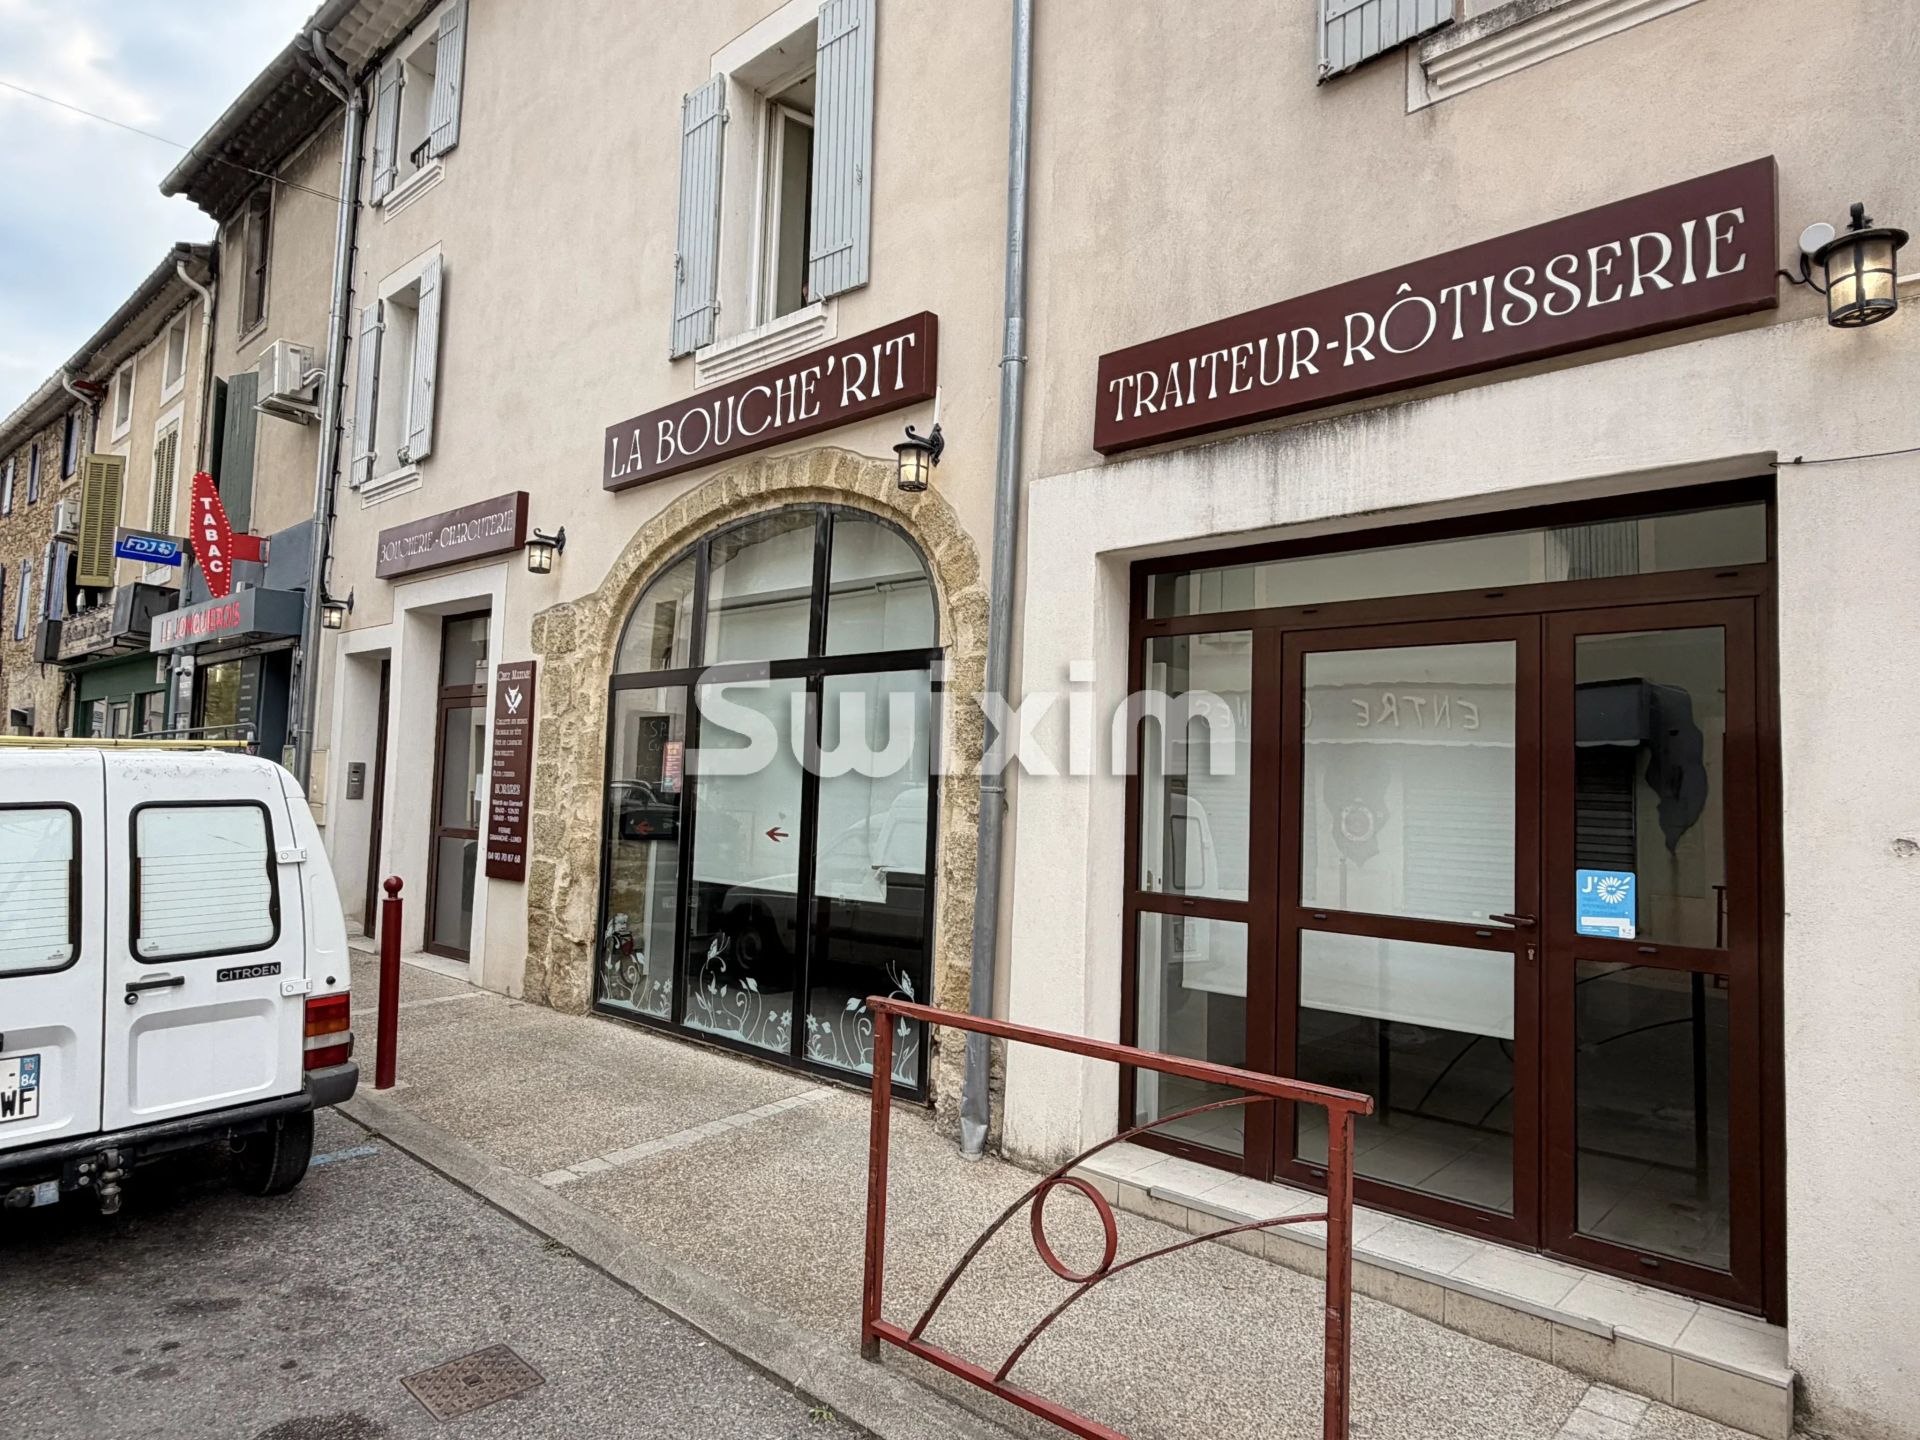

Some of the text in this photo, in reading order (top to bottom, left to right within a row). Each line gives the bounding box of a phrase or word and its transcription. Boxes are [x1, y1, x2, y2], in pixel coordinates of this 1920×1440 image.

[1108, 207, 1747, 422] TRAITEUR-RÔTISSERIE
[611, 332, 916, 478] LA BOUCHE'RIT
[125, 538, 158, 553] FDJ
[200, 497, 224, 573] TABAC
[219, 965, 280, 981] CITROEN
[21, 1073, 36, 1086] 84
[1, 1087, 35, 1118] WF
